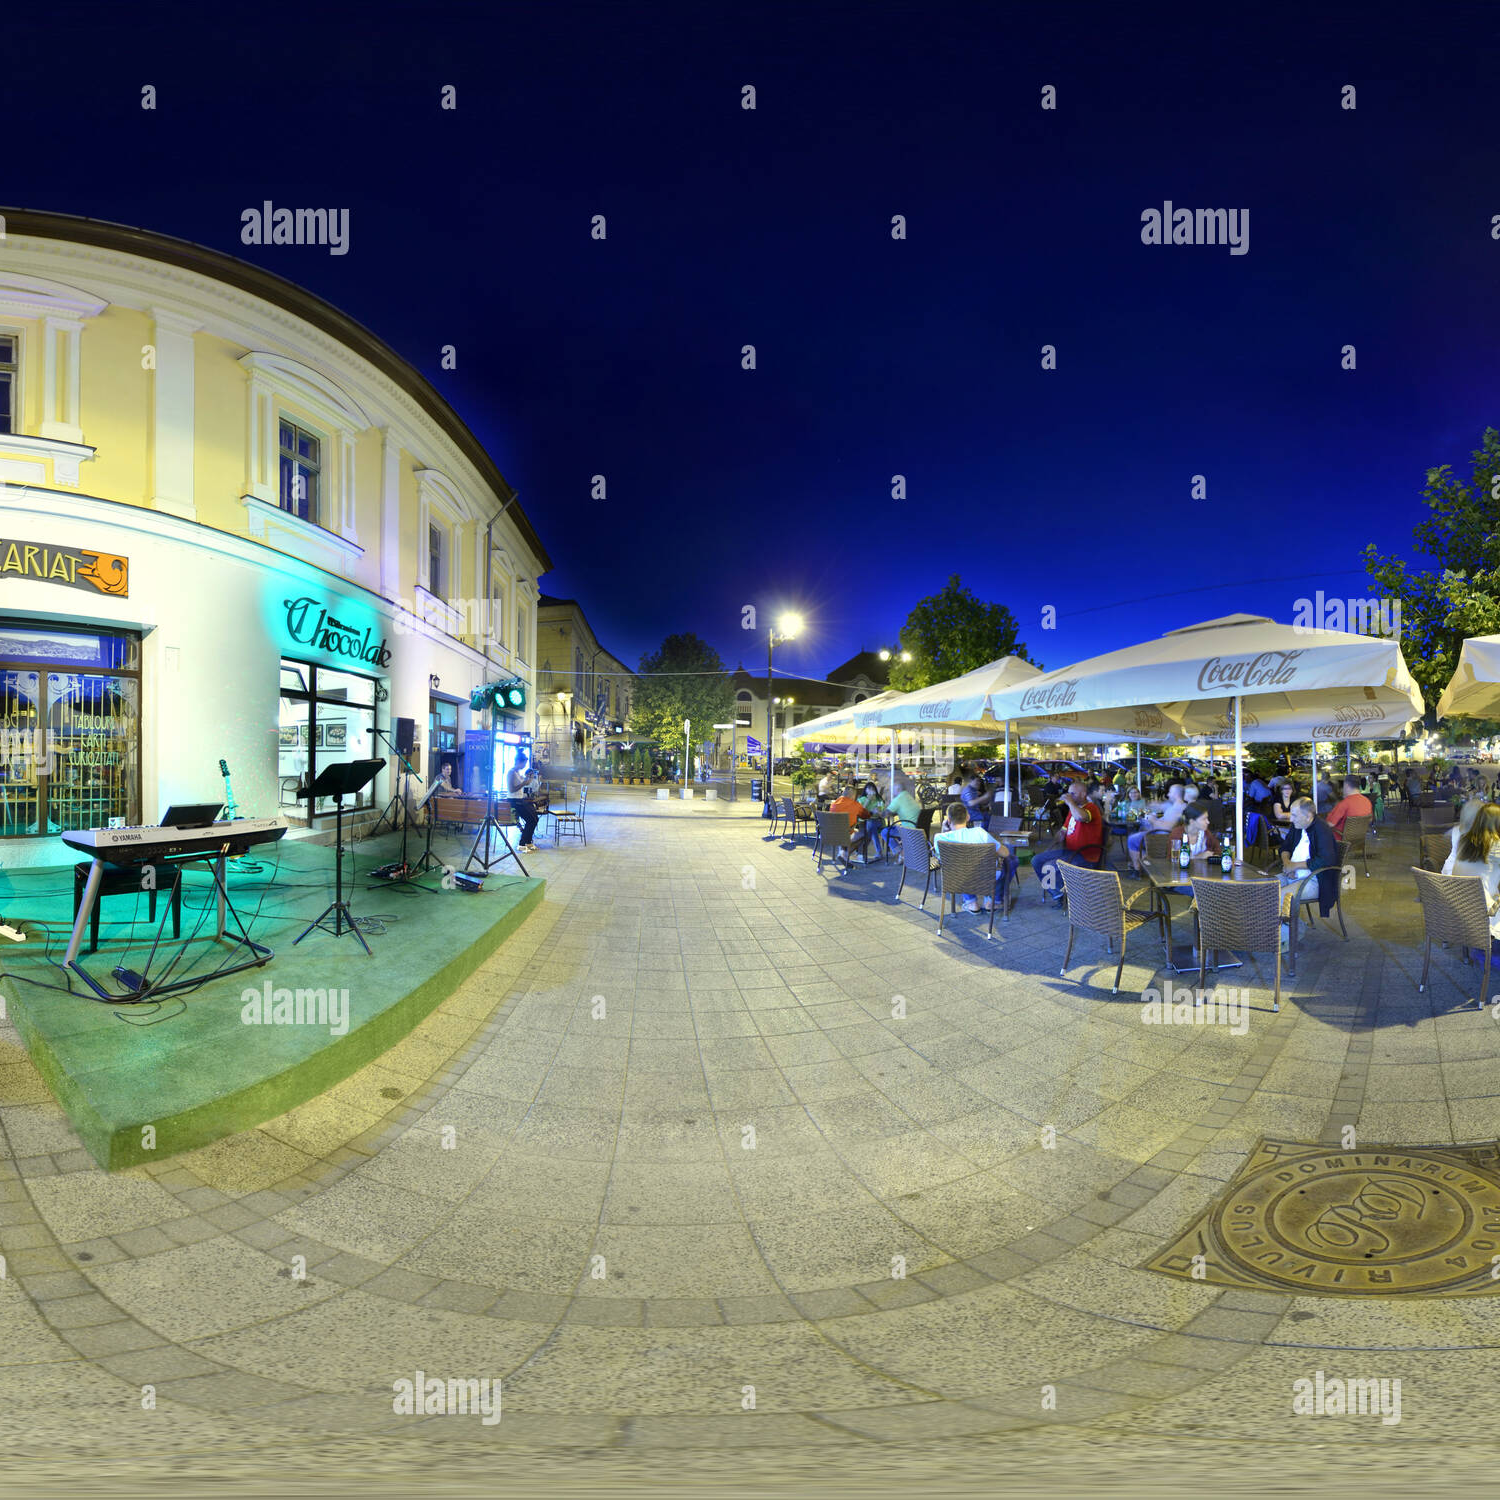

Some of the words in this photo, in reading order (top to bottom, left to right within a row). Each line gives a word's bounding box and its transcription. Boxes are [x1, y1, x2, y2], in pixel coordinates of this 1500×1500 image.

[283, 597, 392, 668] Chocolate
[1197, 649, 1307, 692] Coca-Cola
[1020, 679, 1079, 712] Coca-Cola
[120, 833, 142, 841] YAMAHA
[1275, 1155, 1488, 1194] DOMINARUM
[1230, 1204, 1393, 1284] RIVULUS
